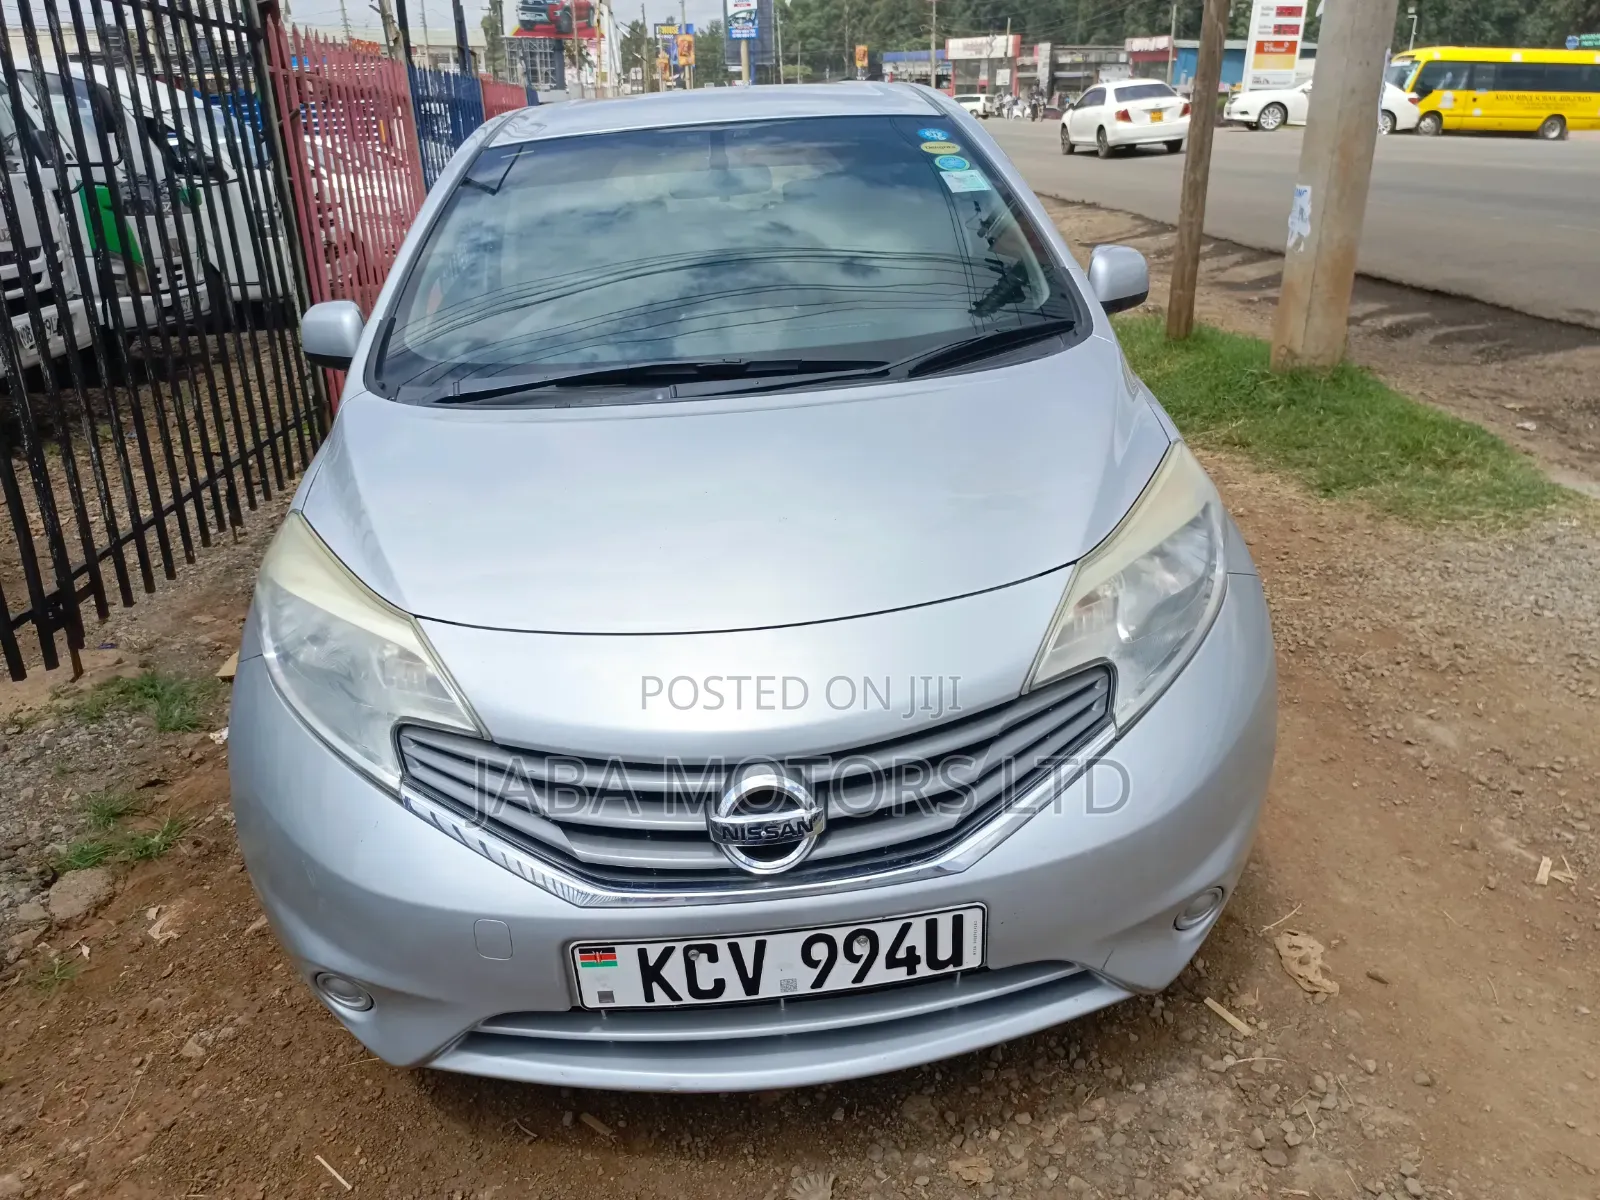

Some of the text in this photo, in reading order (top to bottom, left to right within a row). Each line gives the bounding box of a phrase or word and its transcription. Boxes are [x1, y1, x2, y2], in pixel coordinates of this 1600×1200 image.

[722, 818, 814, 841] NISSAN
[637, 913, 964, 1003] KCV 994U
